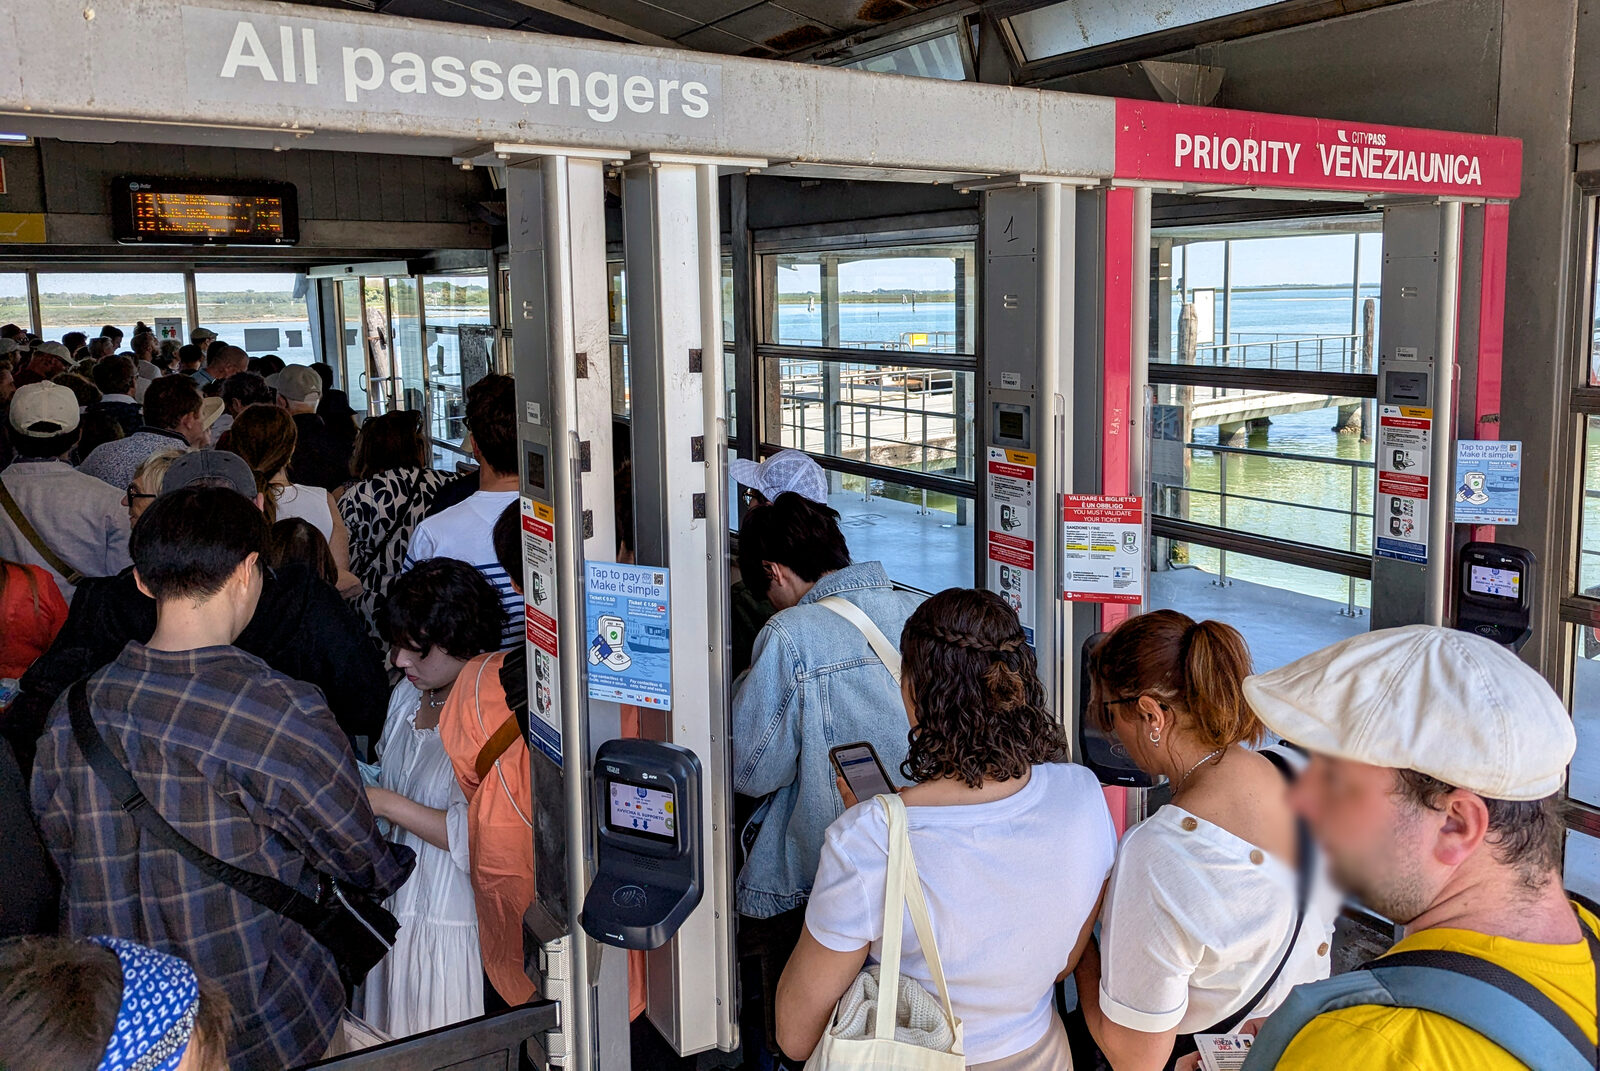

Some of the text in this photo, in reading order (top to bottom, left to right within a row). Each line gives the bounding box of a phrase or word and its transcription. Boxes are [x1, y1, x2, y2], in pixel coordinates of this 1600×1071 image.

[220, 21, 709, 122] All passengers
[1352, 131, 1386, 146] CITYPASS
[1175, 133, 1482, 185] PRIORITY VENEZIAUNICA
[1003, 215, 1019, 242] 1
[590, 567, 641, 583] Tap to pay
[590, 579, 660, 597] Make it simple
[641, 813, 664, 821] SUPPORTO
